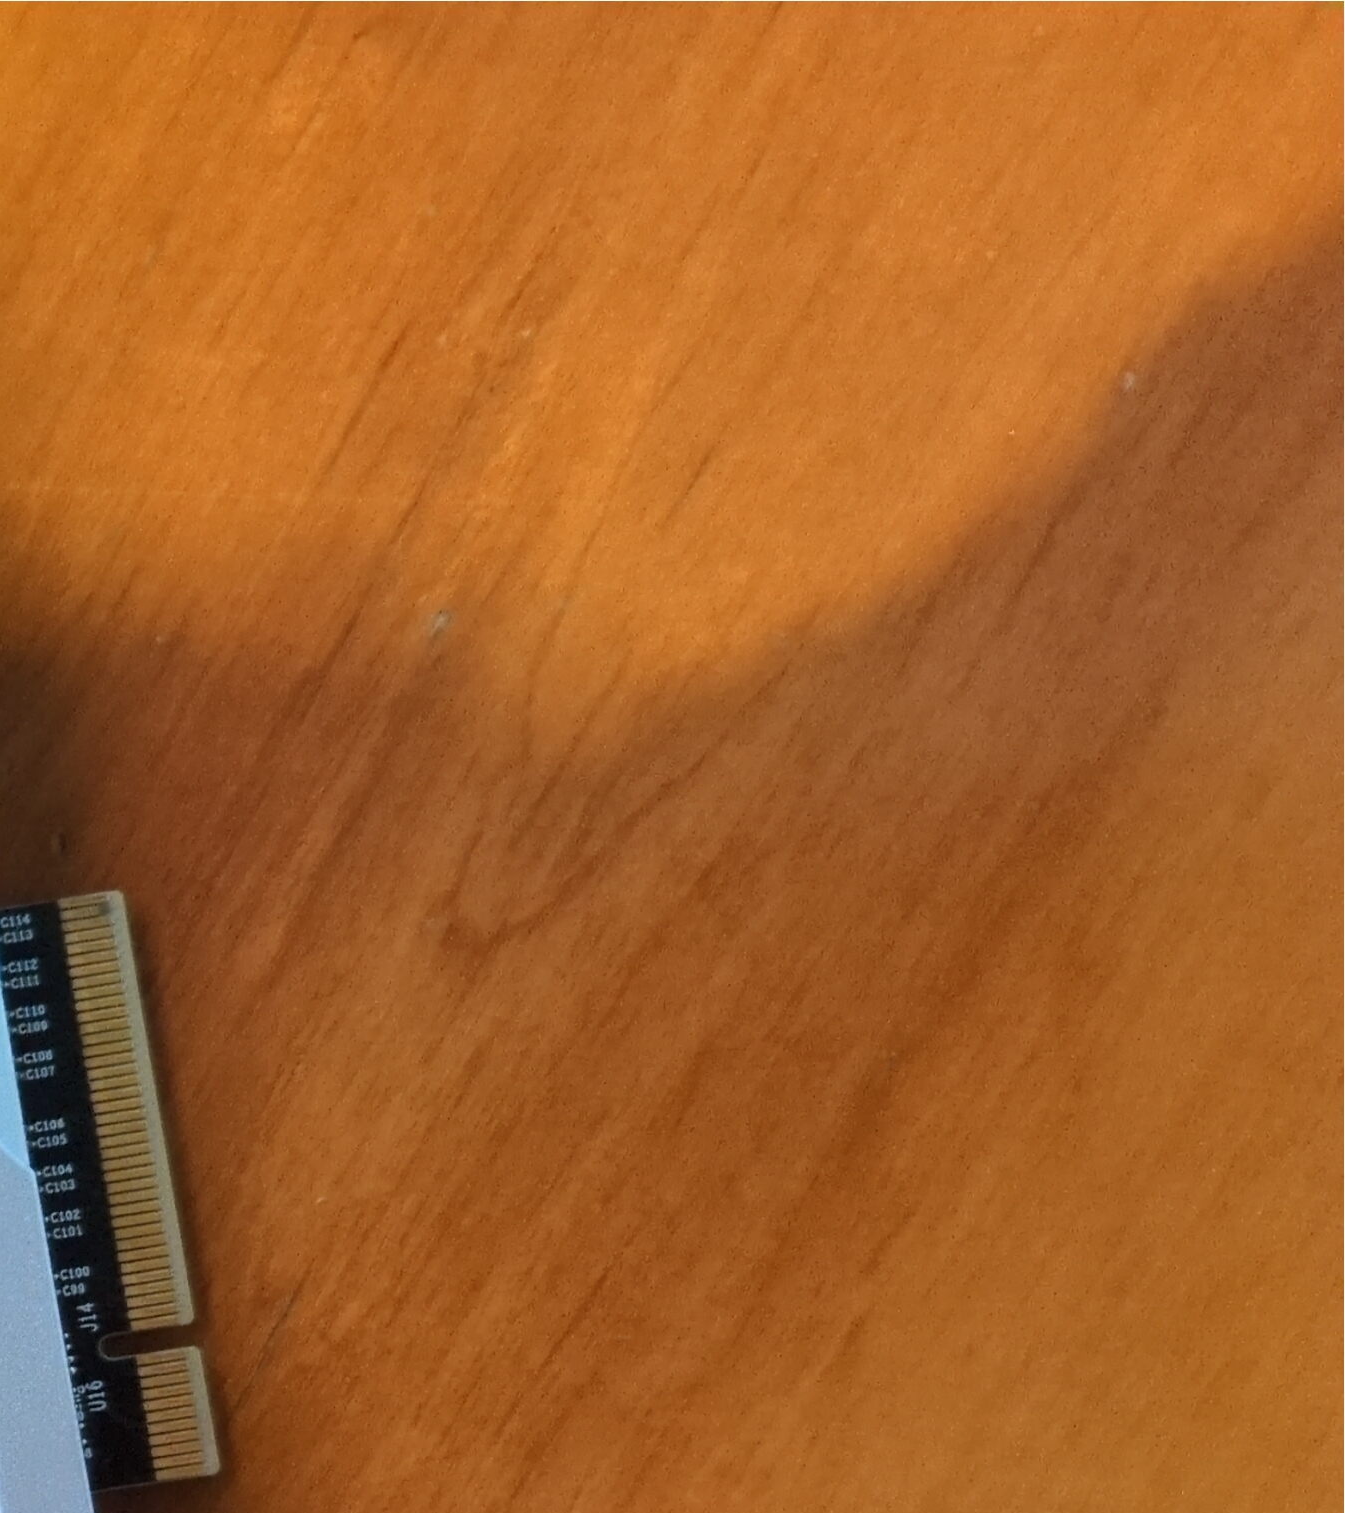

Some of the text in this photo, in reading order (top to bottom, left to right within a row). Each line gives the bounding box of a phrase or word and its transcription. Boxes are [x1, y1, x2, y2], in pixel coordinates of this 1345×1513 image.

[1, 913, 31, 928] C114
[3, 929, 34, 944] C113
[7, 958, 39, 973] C112
[11, 975, 40, 989] C111
[16, 1004, 46, 1018] C110
[18, 1020, 49, 1034] C109
[23, 1050, 54, 1064] C108
[26, 1065, 56, 1080] C107
[35, 1117, 65, 1132] C106
[37, 1133, 68, 1148] C105
[43, 1163, 74, 1177] C104
[45, 1179, 76, 1194] C103
[50, 1208, 81, 1223] C102
[53, 1224, 83, 1239] C101
[60, 1266, 90, 1280] C100
[63, 1283, 86, 1297] C99
[76, 1302, 99, 1332] J14
[85, 1380, 107, 1412] U16
